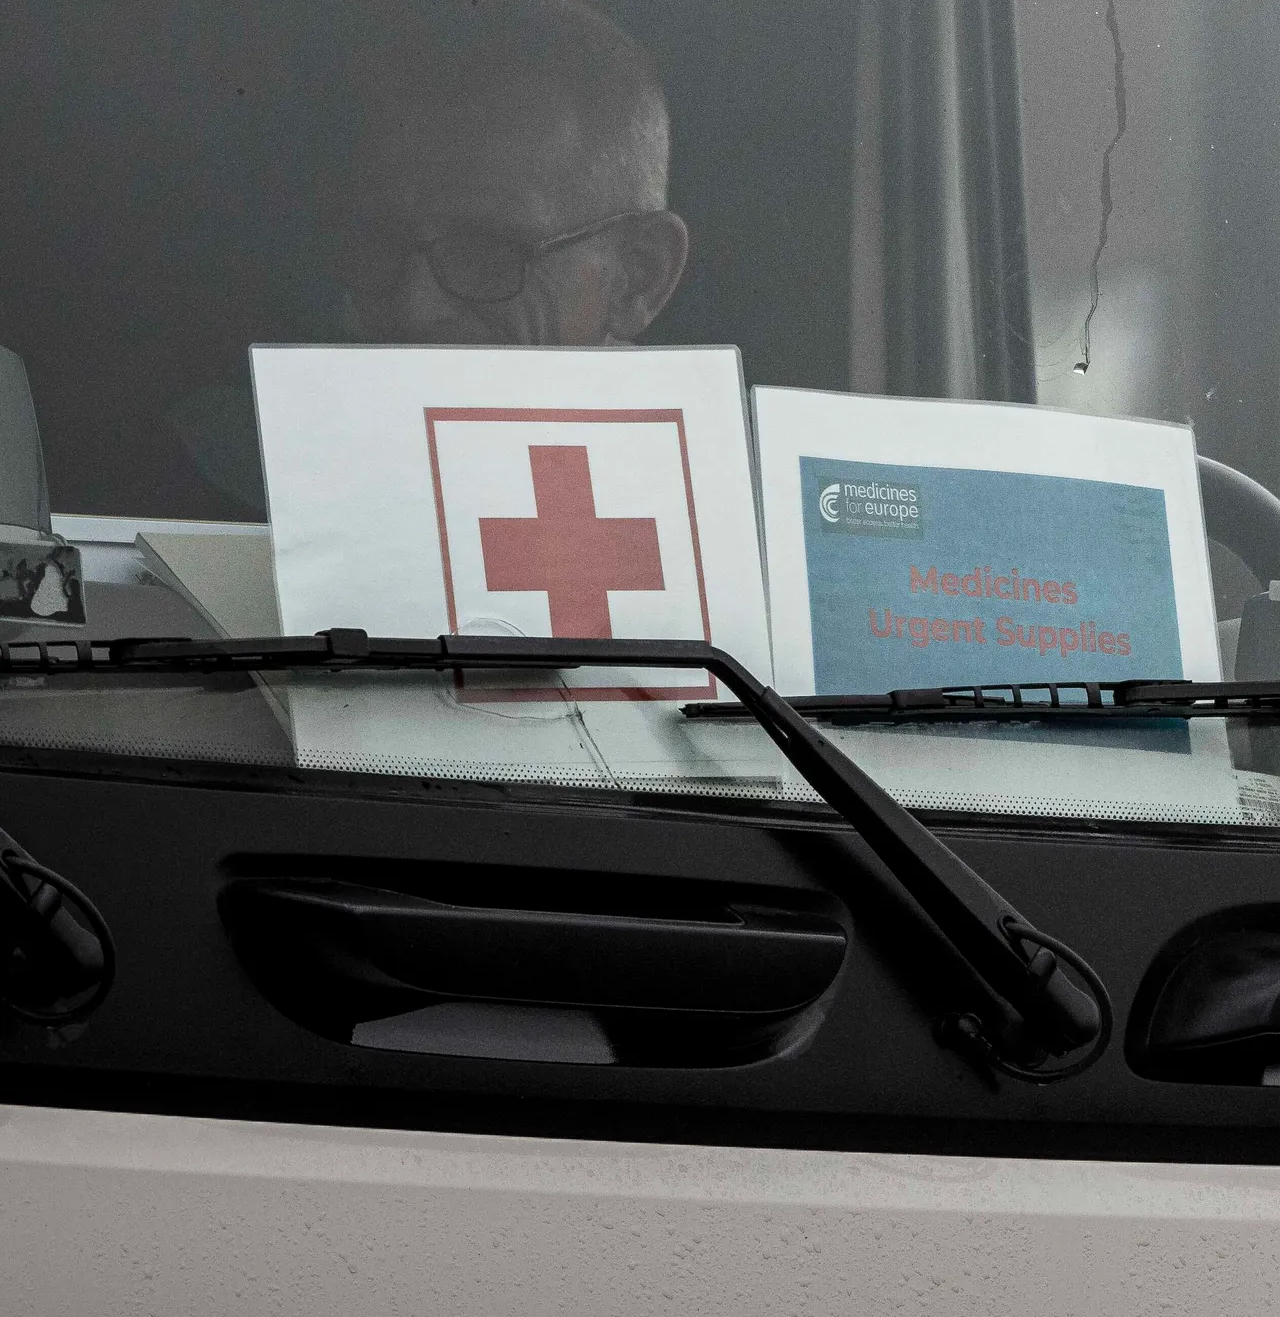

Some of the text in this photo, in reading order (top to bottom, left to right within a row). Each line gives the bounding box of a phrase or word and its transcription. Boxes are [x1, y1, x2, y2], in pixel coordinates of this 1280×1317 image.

[844, 482, 917, 501] medicines
[845, 498, 919, 521] for europe
[909, 565, 1079, 605] Medicines
[868, 609, 1132, 658] Urgent Supplies
